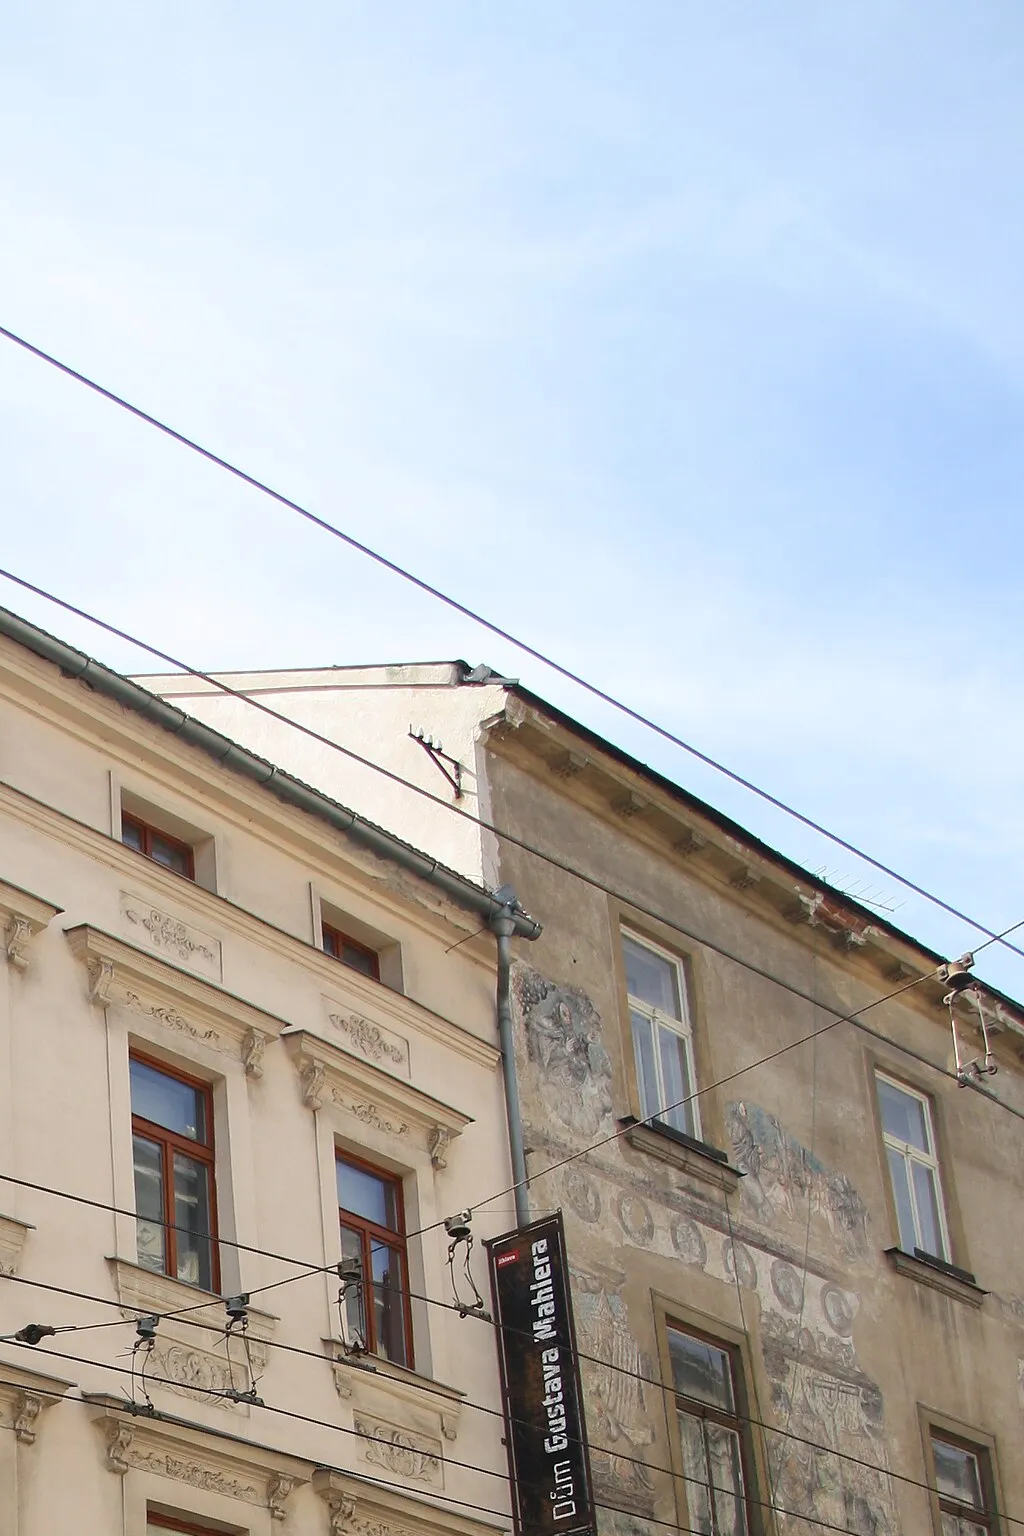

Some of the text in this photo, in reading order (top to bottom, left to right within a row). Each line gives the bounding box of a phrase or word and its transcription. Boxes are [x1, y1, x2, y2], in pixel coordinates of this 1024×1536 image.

[529, 1239, 576, 1520] Dům Gustava Mahlera
